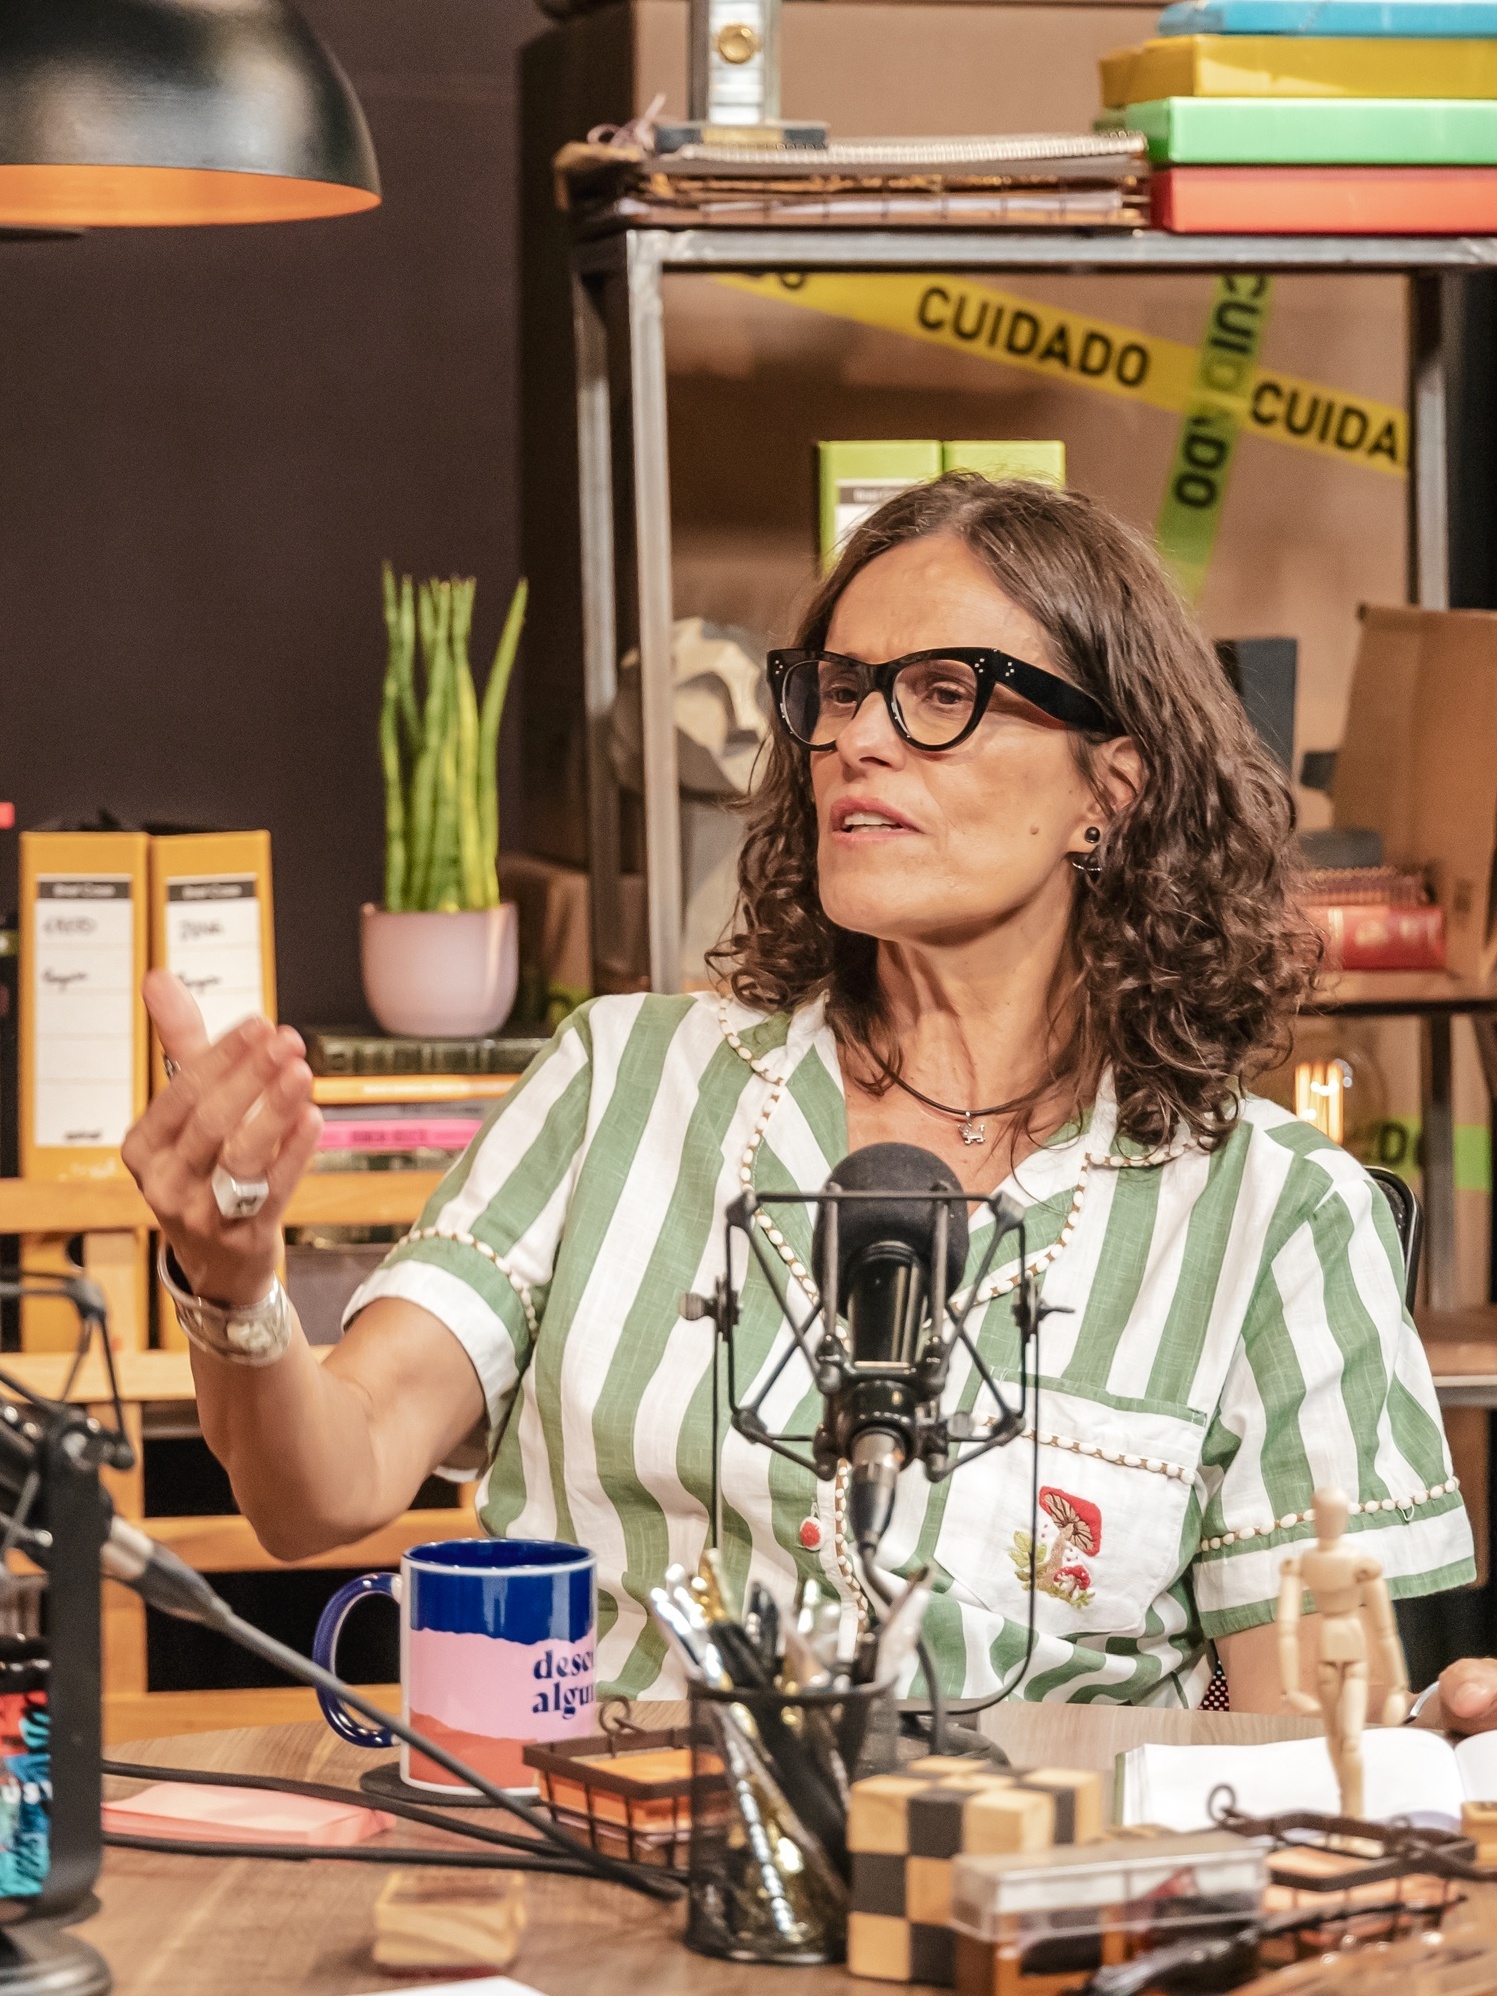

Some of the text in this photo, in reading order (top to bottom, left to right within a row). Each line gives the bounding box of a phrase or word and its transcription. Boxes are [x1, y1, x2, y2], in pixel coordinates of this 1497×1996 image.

[917, 286, 1150, 388] CUIDADO
[533, 1650, 594, 1679] desc
[532, 1682, 594, 1720] algu
